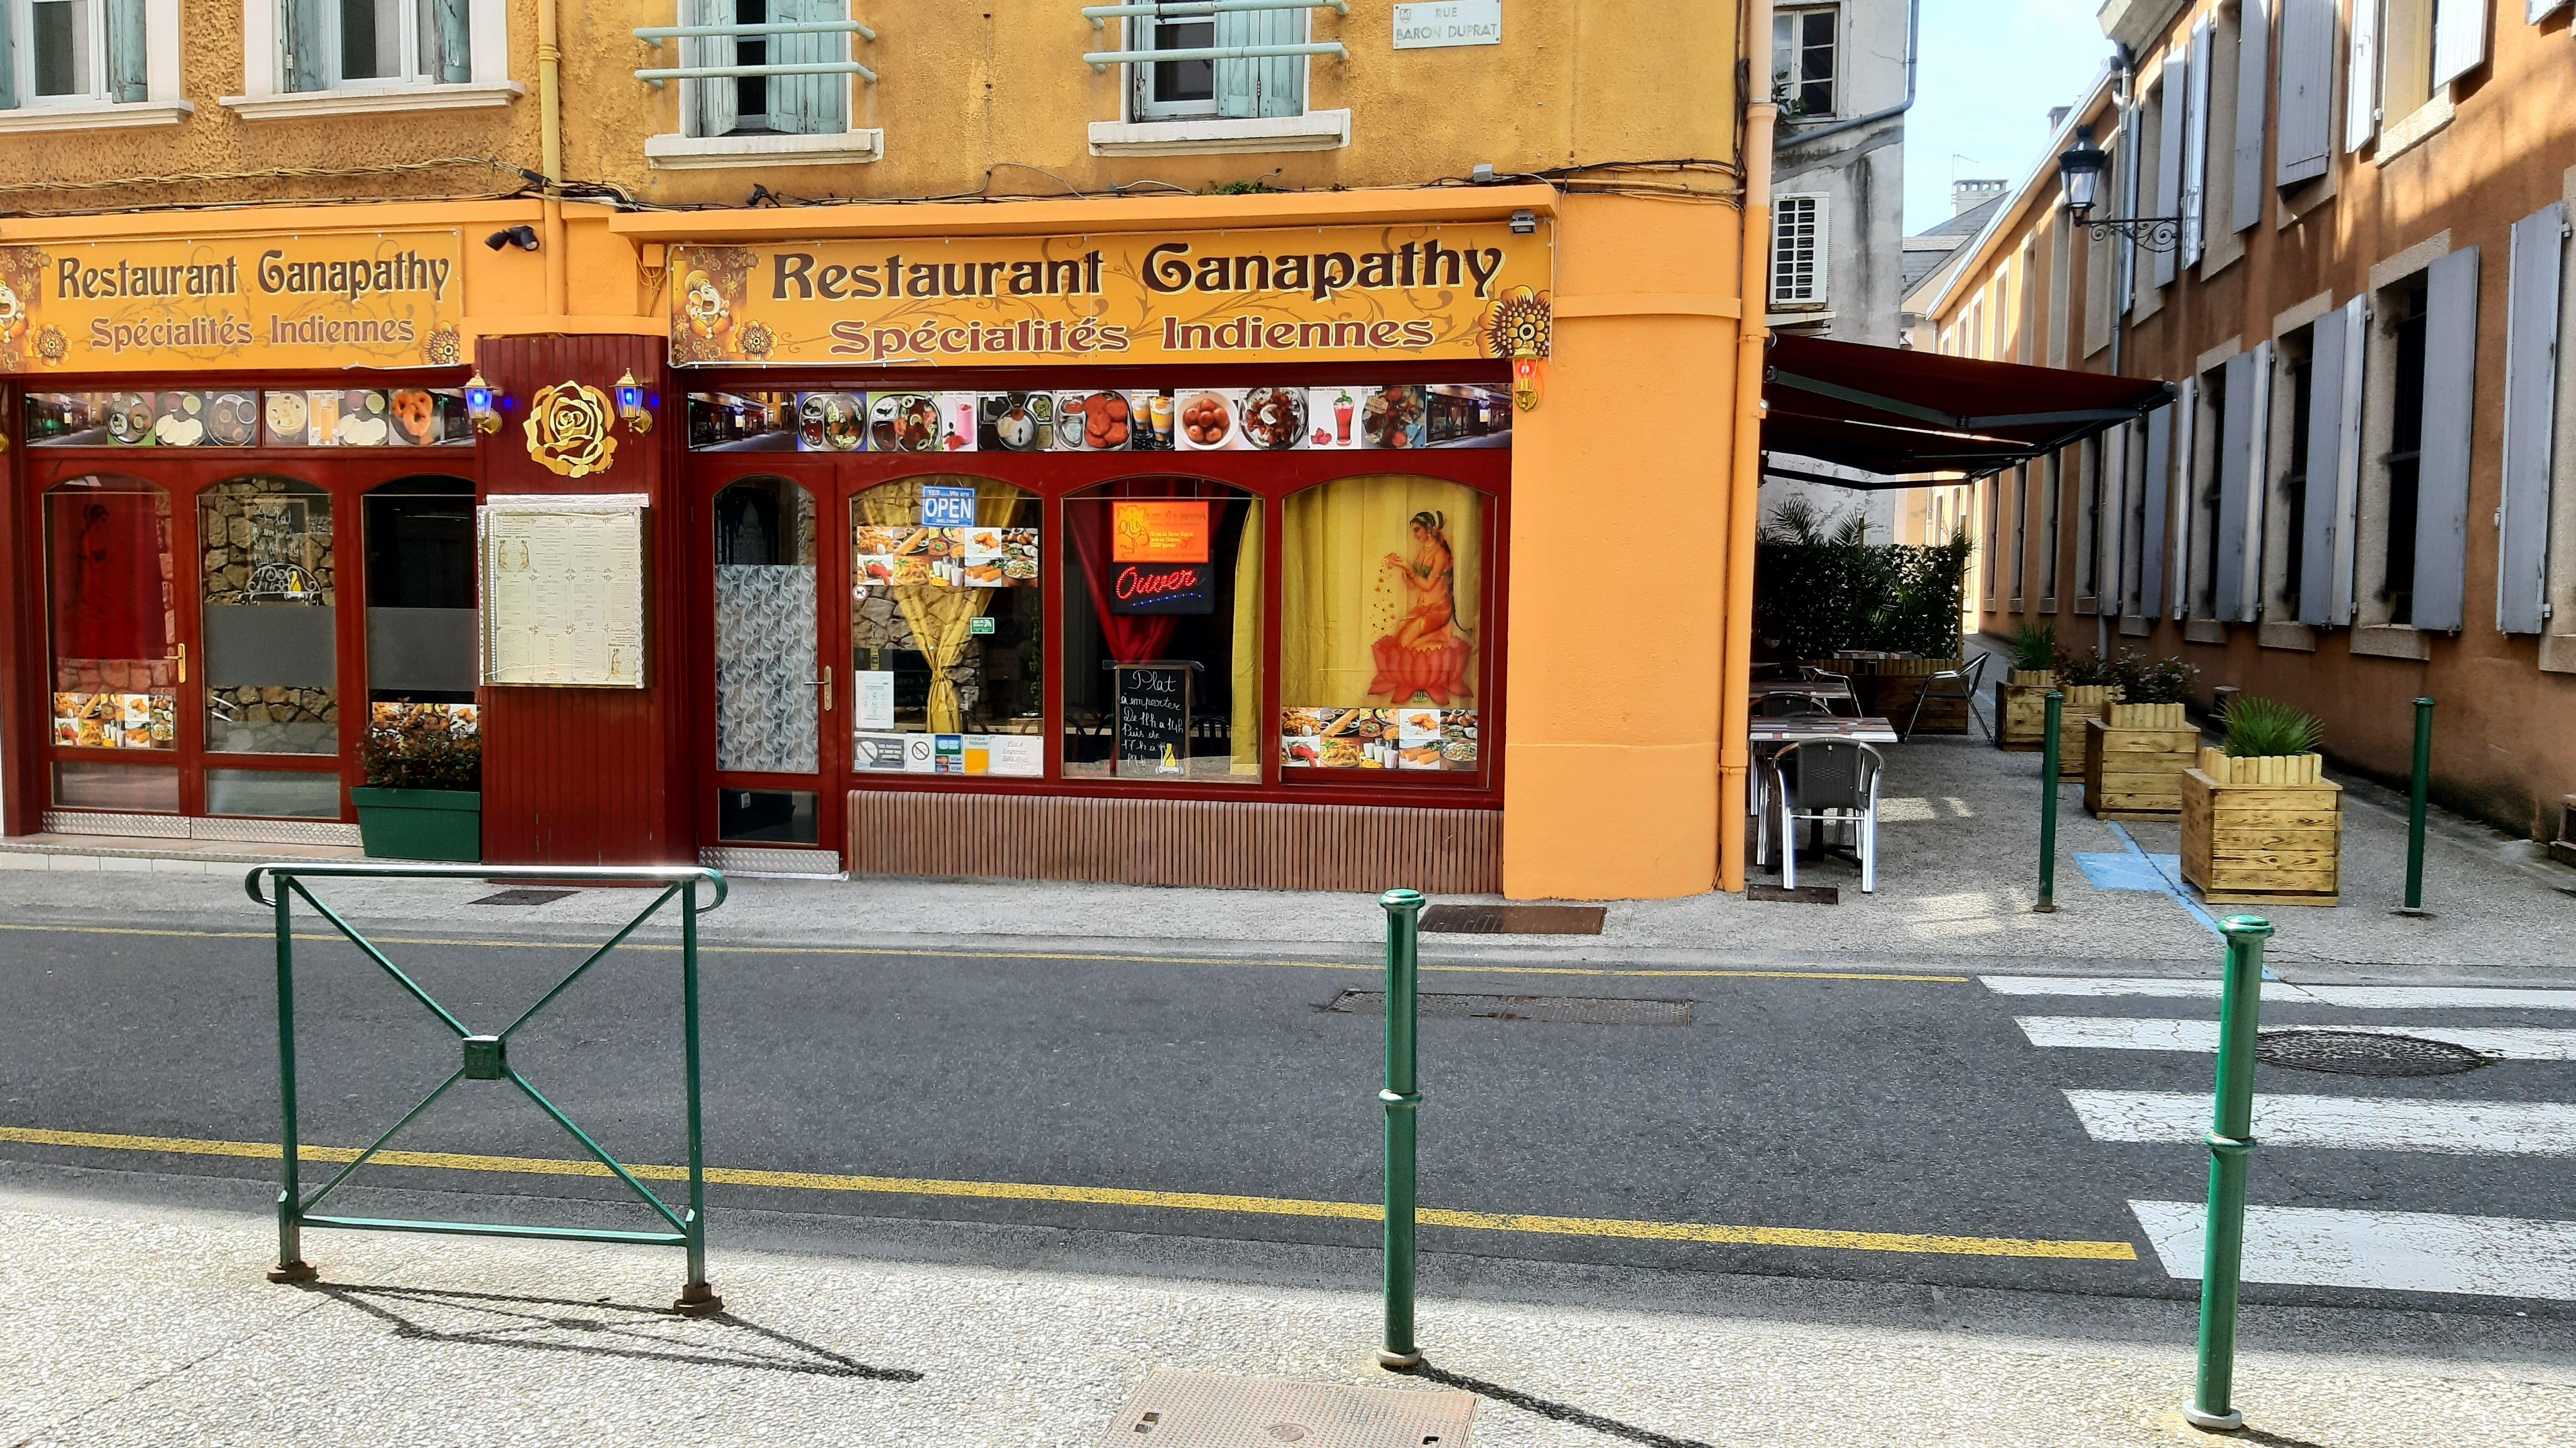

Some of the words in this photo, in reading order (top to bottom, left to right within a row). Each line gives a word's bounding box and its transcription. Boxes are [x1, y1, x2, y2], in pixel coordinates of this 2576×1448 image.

[1436, 7, 1457, 18] RUE
[1396, 26, 1441, 40] BARON
[1448, 24, 1498, 38] DUPRAT
[57, 255, 237, 299] Restaurant
[257, 250, 450, 304] Ganapathy
[772, 250, 1104, 300] Restaurant
[1142, 239, 1505, 302] Ganapathy
[91, 312, 252, 354] Spécialités
[271, 315, 414, 345] Indiennes
[829, 316, 1129, 362] Spécialités
[1161, 315, 1436, 352] Indiennes
[925, 498, 971, 519] OPEN
[1128, 669, 1176, 692] Plat
[1121, 693, 1128, 705] à
[1130, 697, 1181, 710] emporter
[1122, 723, 1144, 738] Puis
[1147, 730, 1160, 739] de
[1123, 706, 1137, 722] De
[1167, 718, 1183, 734] 14h
[938, 739, 959, 749] CB
